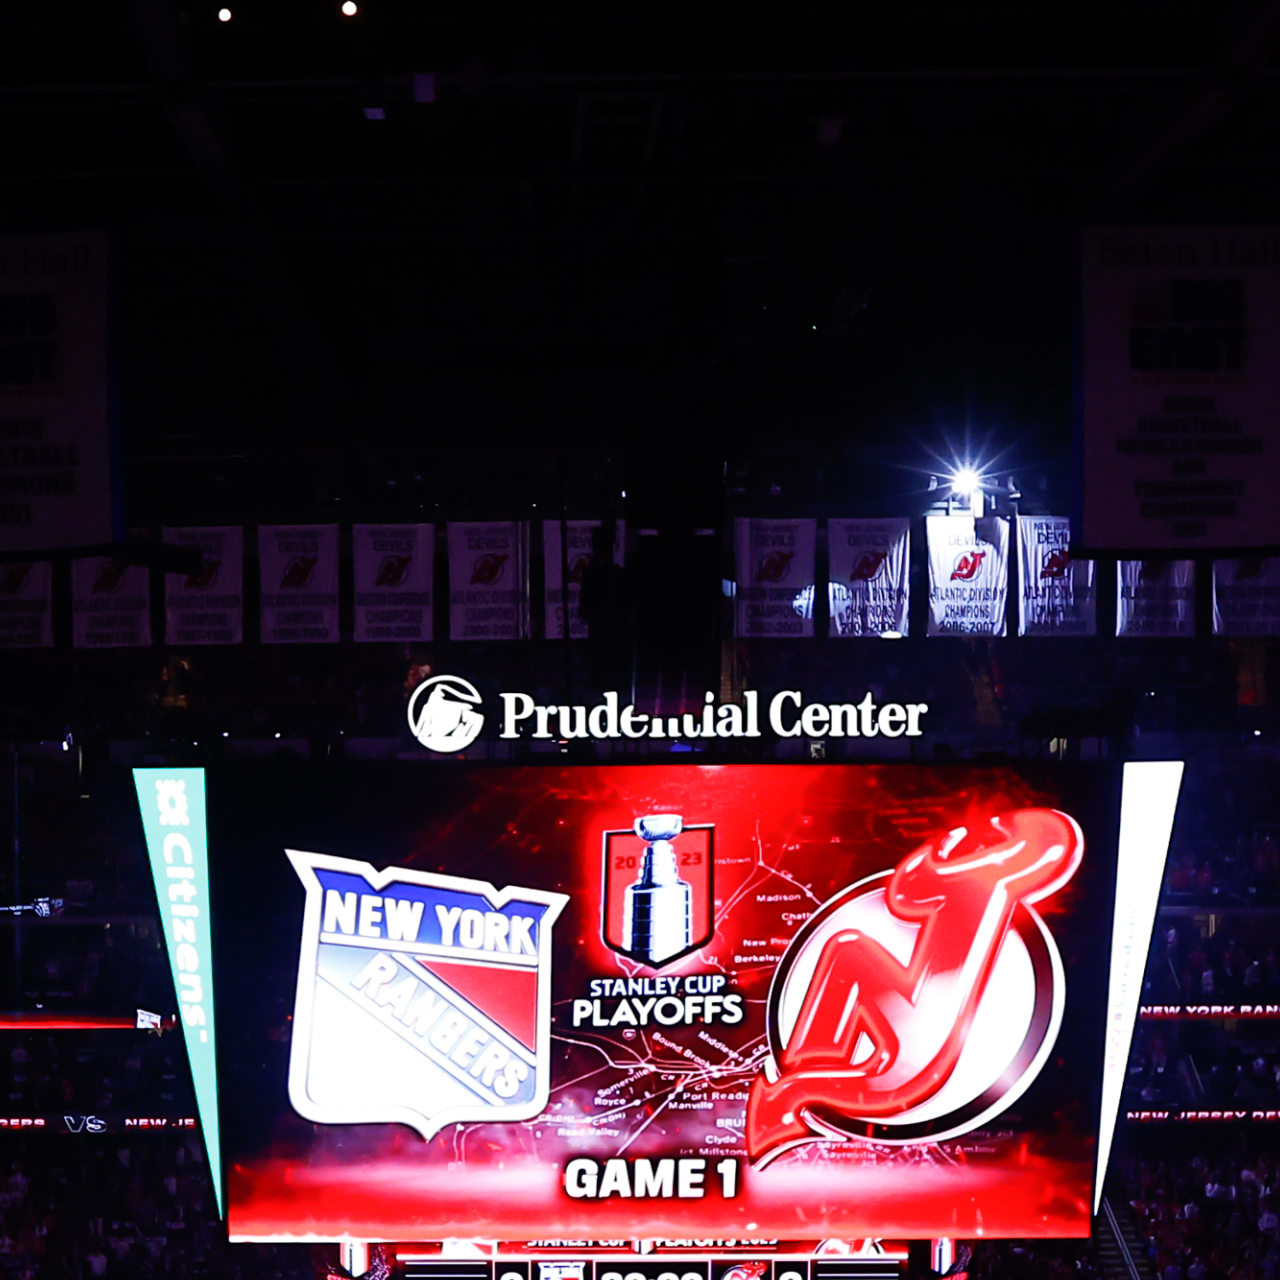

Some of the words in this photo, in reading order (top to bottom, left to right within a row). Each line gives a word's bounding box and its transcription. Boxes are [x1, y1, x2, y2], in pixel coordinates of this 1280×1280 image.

[1037, 532, 1070, 545] DEVIL
[769, 690, 928, 738] Center
[614, 855, 637, 870] 20
[680, 852, 702, 866] 23
[756, 892, 801, 902] Madison
[163, 832, 205, 1028] Citizens
[323, 889, 424, 942] NEW
[435, 904, 538, 956] YORK
[742, 938, 767, 948] New
[734, 954, 781, 964] Berkeley
[590, 976, 681, 997] STANLEY
[684, 975, 726, 995] CUP
[572, 994, 743, 1028] PLAYOFFS
[1139, 1003, 1183, 1018] NEW
[1185, 1003, 1235, 1018] YORK
[350, 952, 529, 1100] RANGERS
[668, 1101, 714, 1110] Manville
[64, 1115, 108, 1133] VS
[124, 1118, 167, 1130] NEW
[1126, 1110, 1171, 1123] NEW
[1174, 1110, 1247, 1123] JERSEY
[565, 1158, 706, 1199] GAME
[716, 1158, 738, 1199] 1
